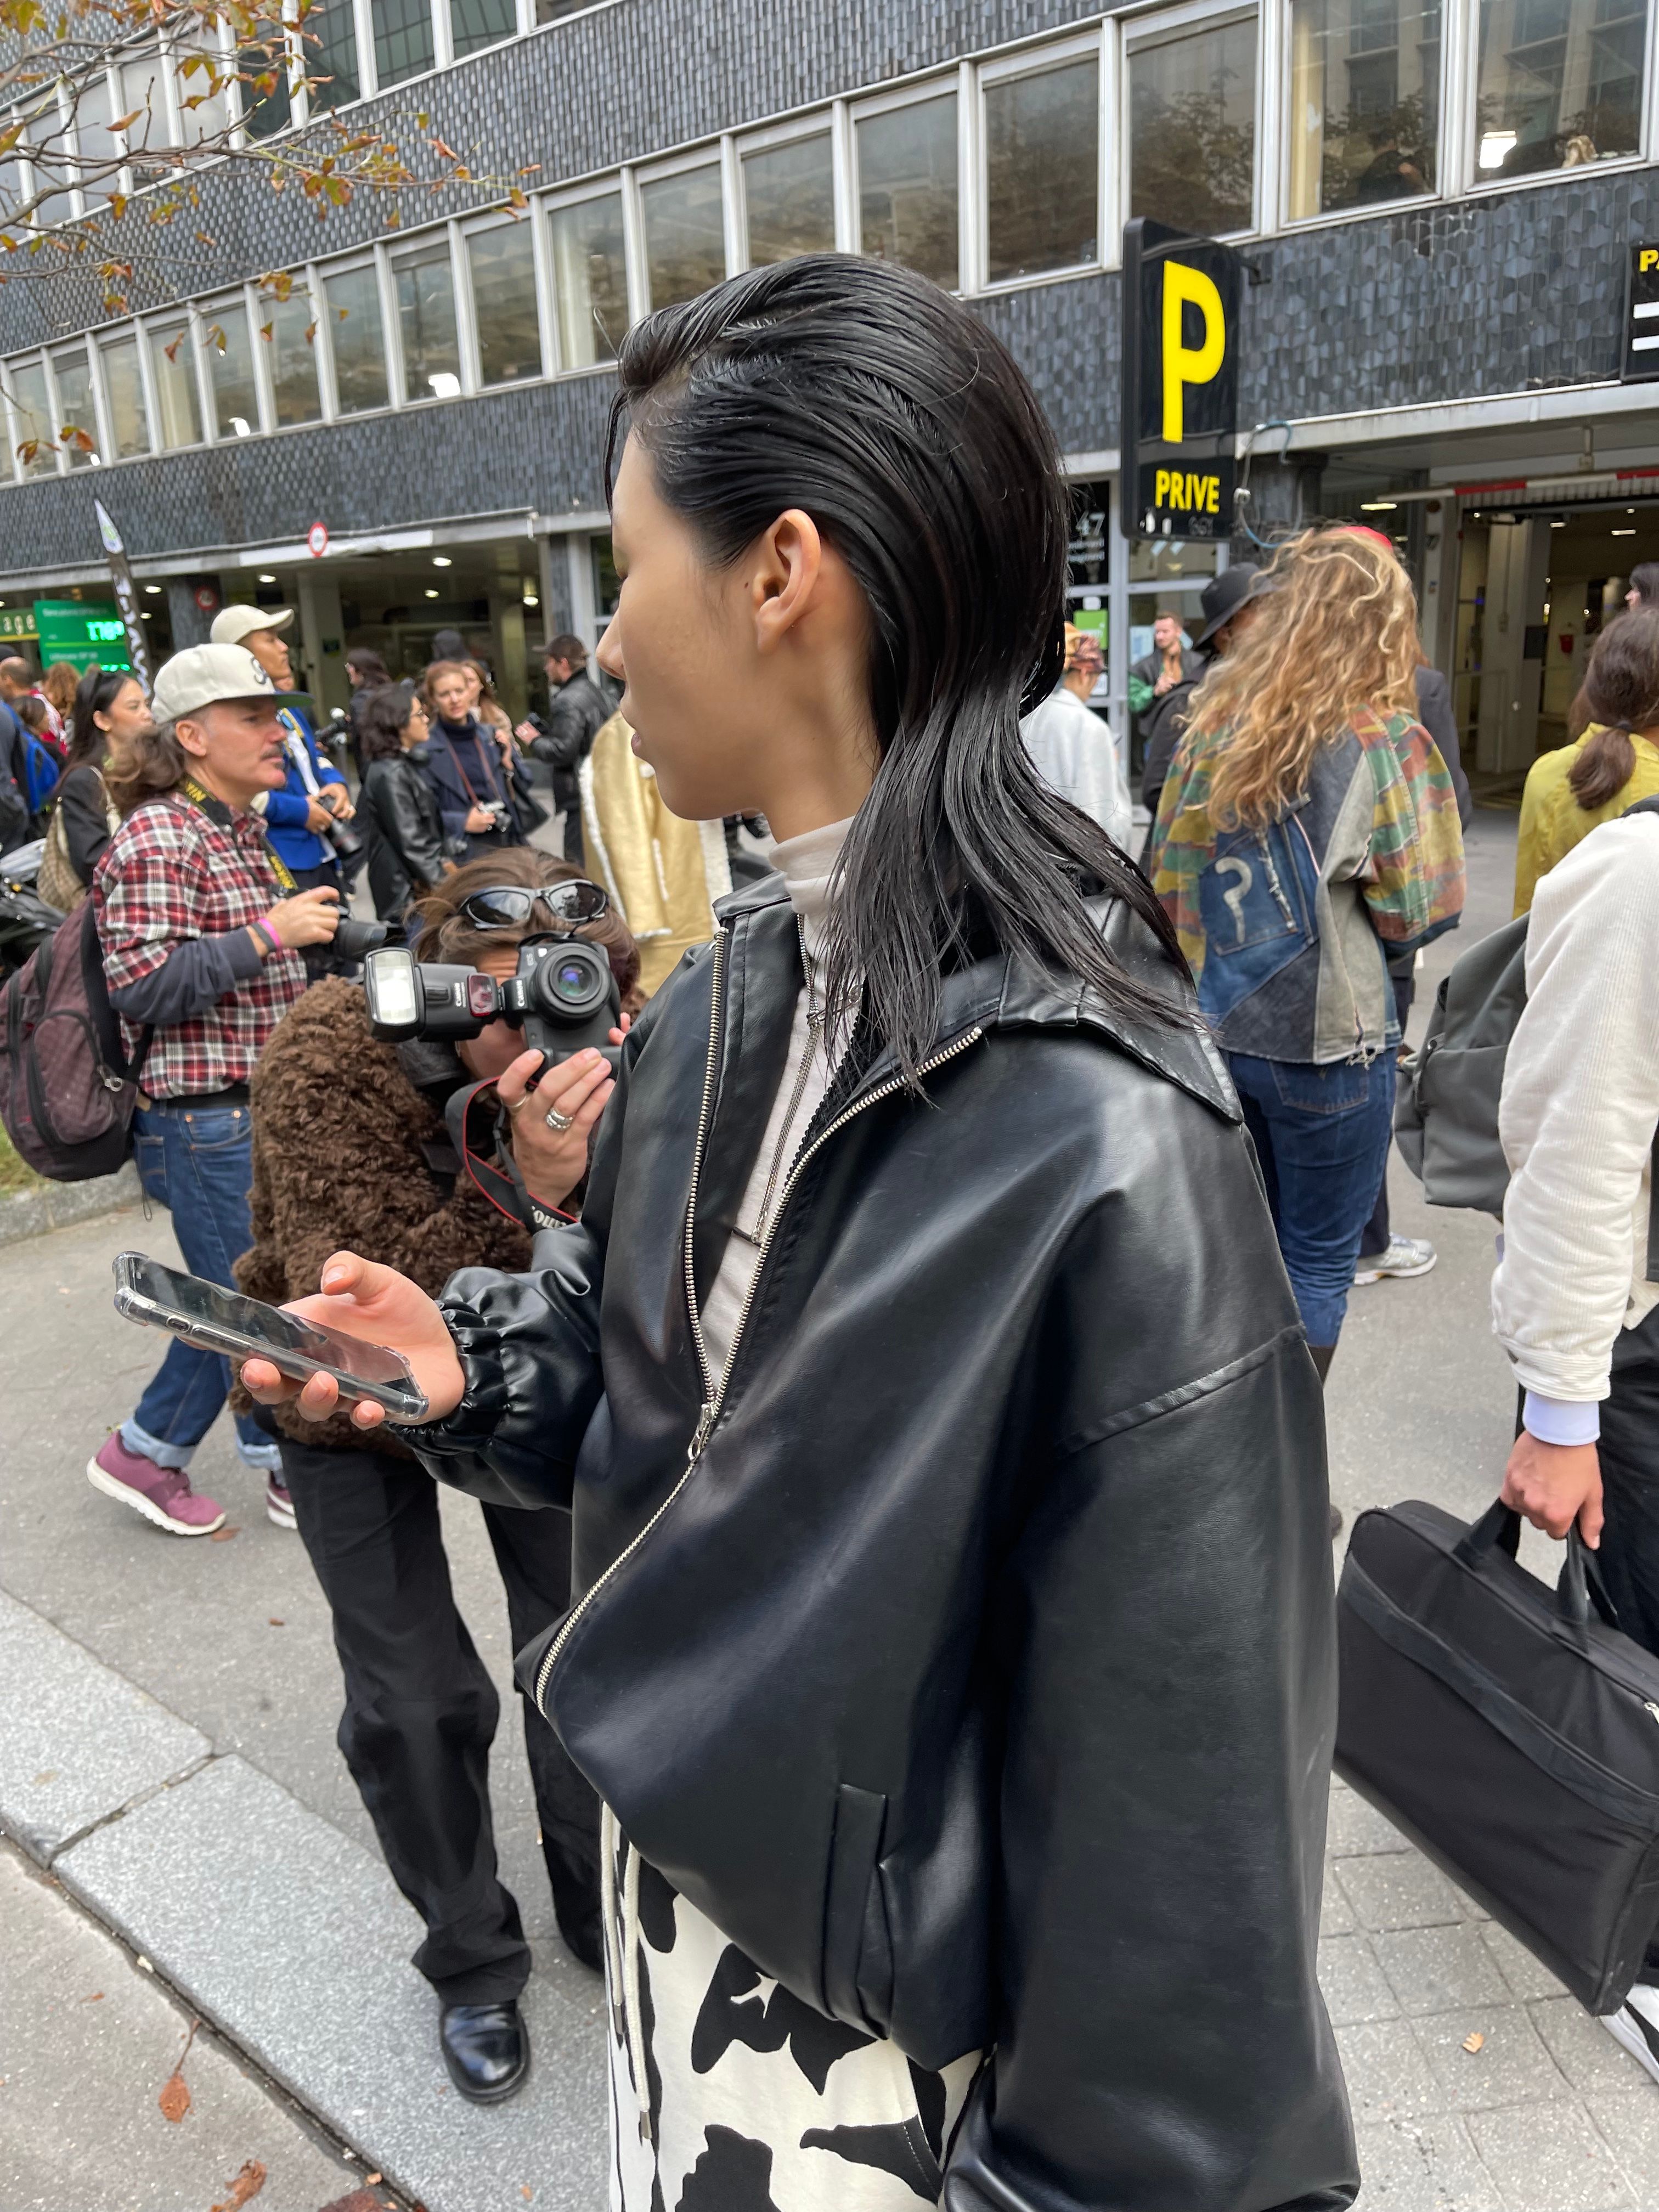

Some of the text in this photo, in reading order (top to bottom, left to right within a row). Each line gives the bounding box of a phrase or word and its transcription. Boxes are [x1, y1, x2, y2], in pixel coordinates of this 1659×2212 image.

[1639, 249, 1659, 272] P
[1162, 259, 1226, 444] P
[1155, 469, 1220, 514] PRIVE
